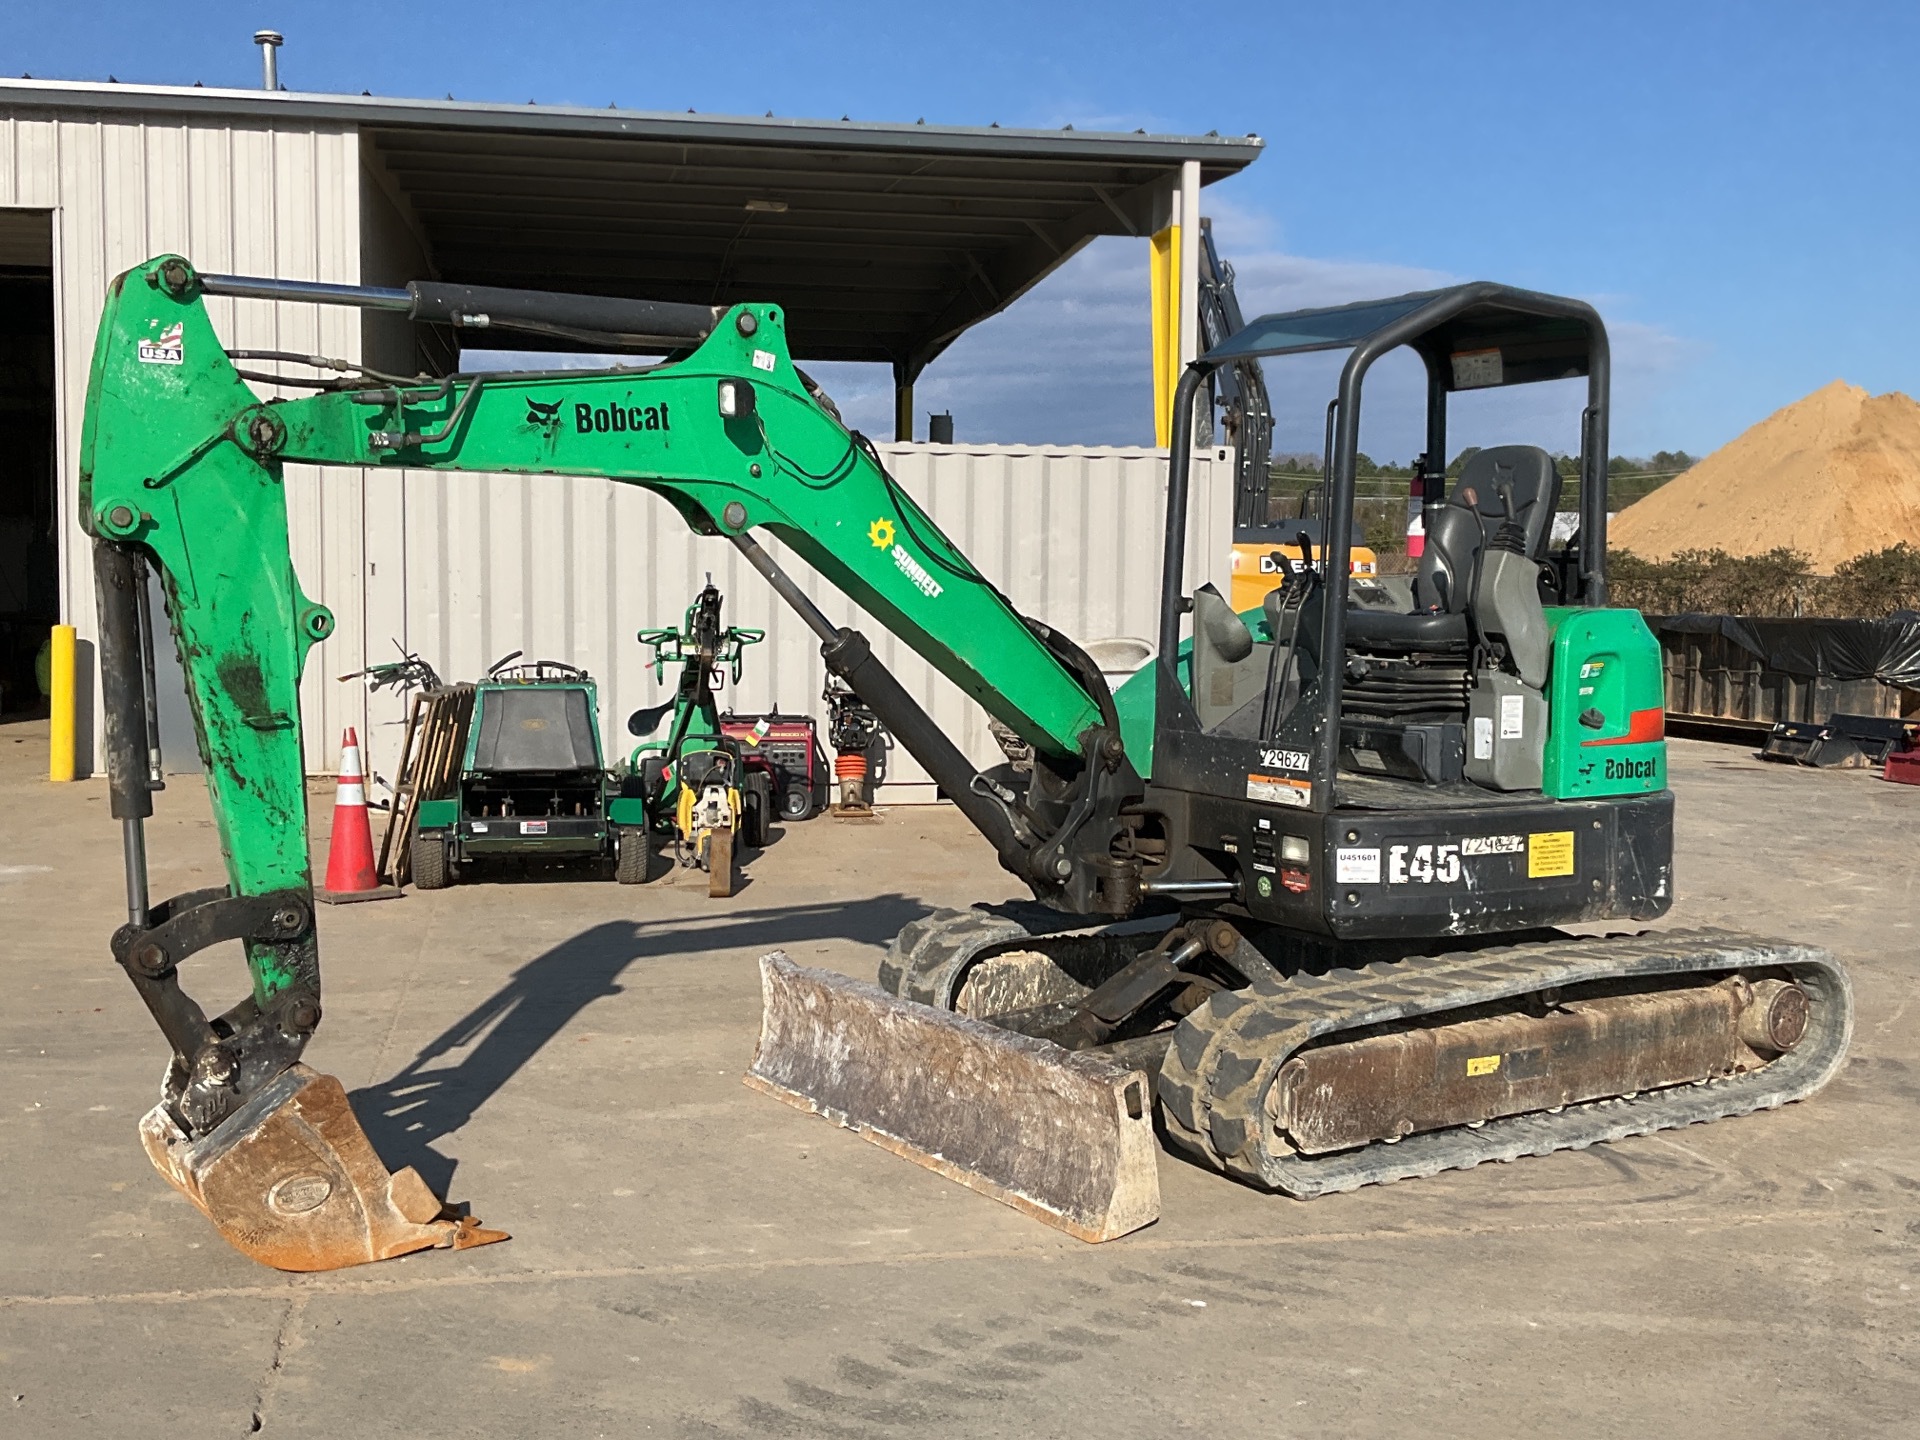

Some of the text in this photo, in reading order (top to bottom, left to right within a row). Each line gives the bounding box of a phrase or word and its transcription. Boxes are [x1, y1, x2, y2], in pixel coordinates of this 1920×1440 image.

[141, 348, 180, 360] USA
[574, 401, 671, 434] Bobcat
[890, 543, 945, 599] SUNBELT
[893, 560, 931, 597] RENTALS
[1605, 757, 1656, 780] Bobcat
[1389, 844, 1461, 884] E45
